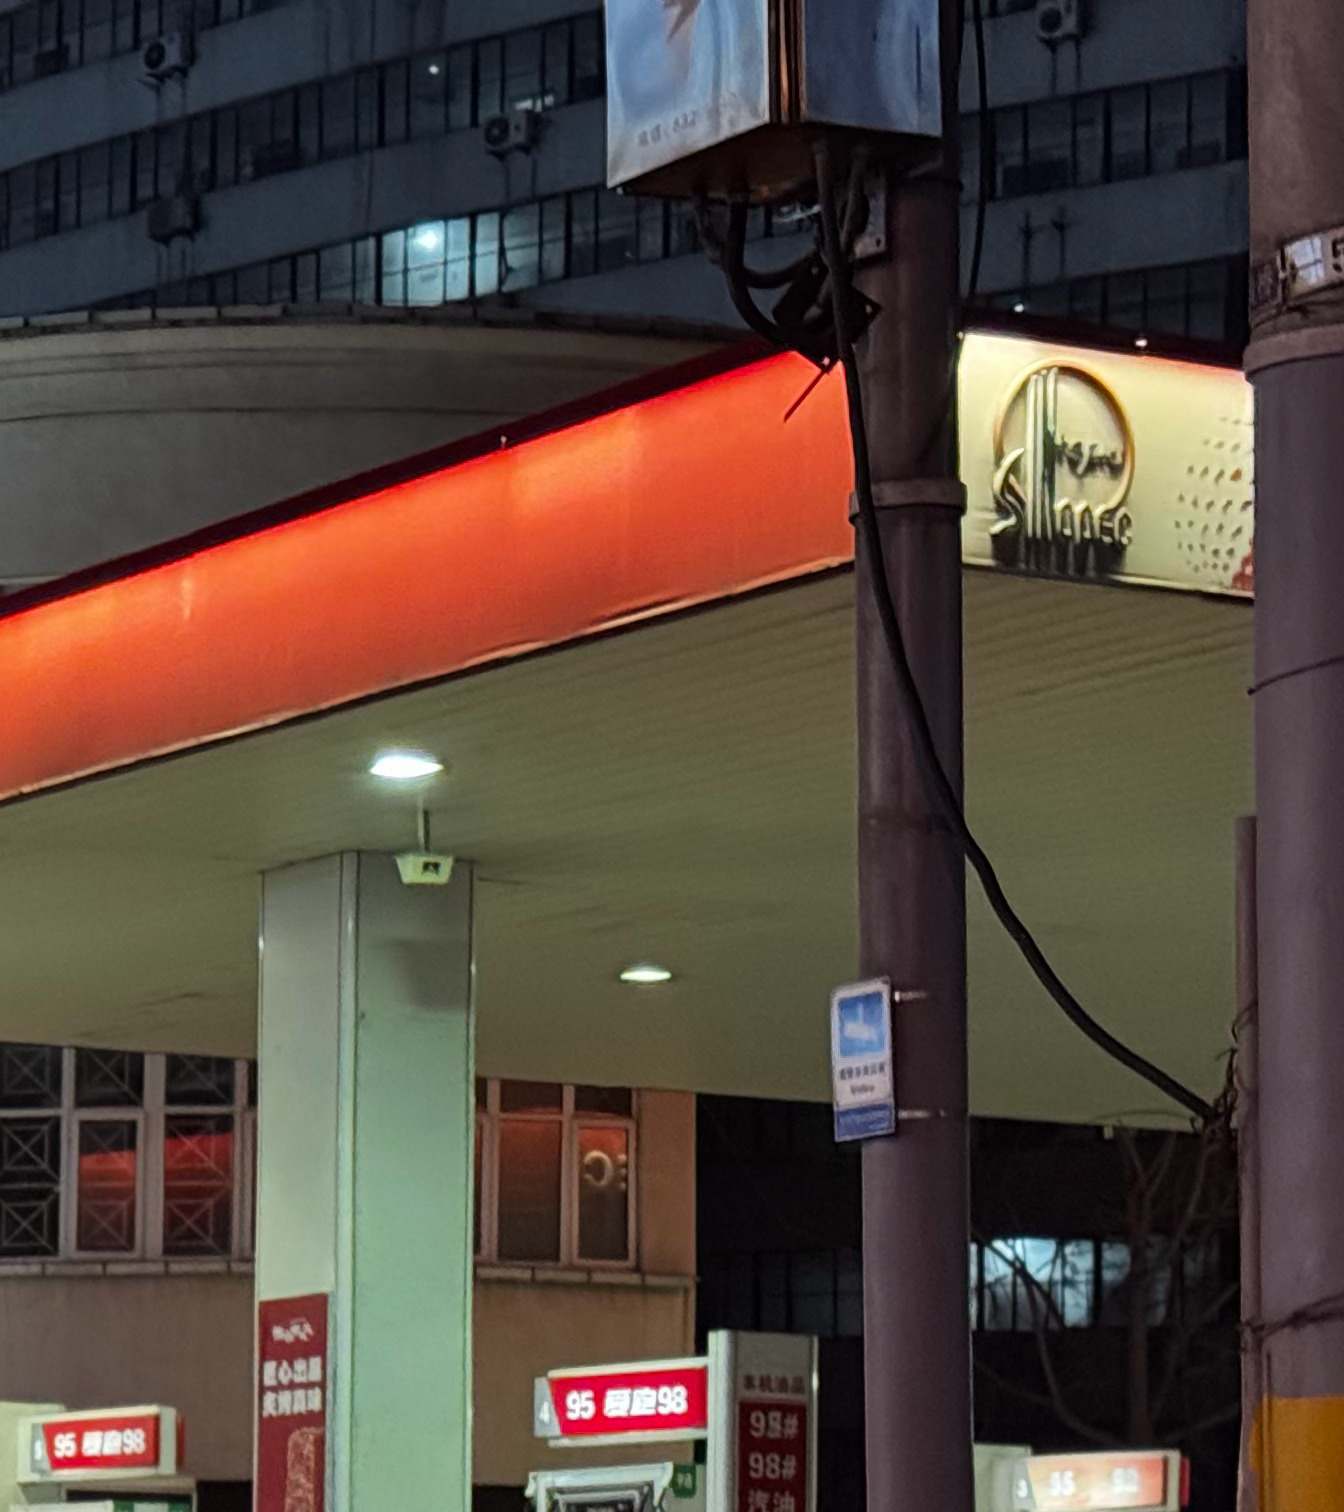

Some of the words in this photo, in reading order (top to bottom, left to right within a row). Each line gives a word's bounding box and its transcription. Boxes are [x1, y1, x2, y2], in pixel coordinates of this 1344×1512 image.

[566, 1389, 596, 1420] 95
[53, 1432, 77, 1459] 95
[748, 1452, 796, 1479] 98#
